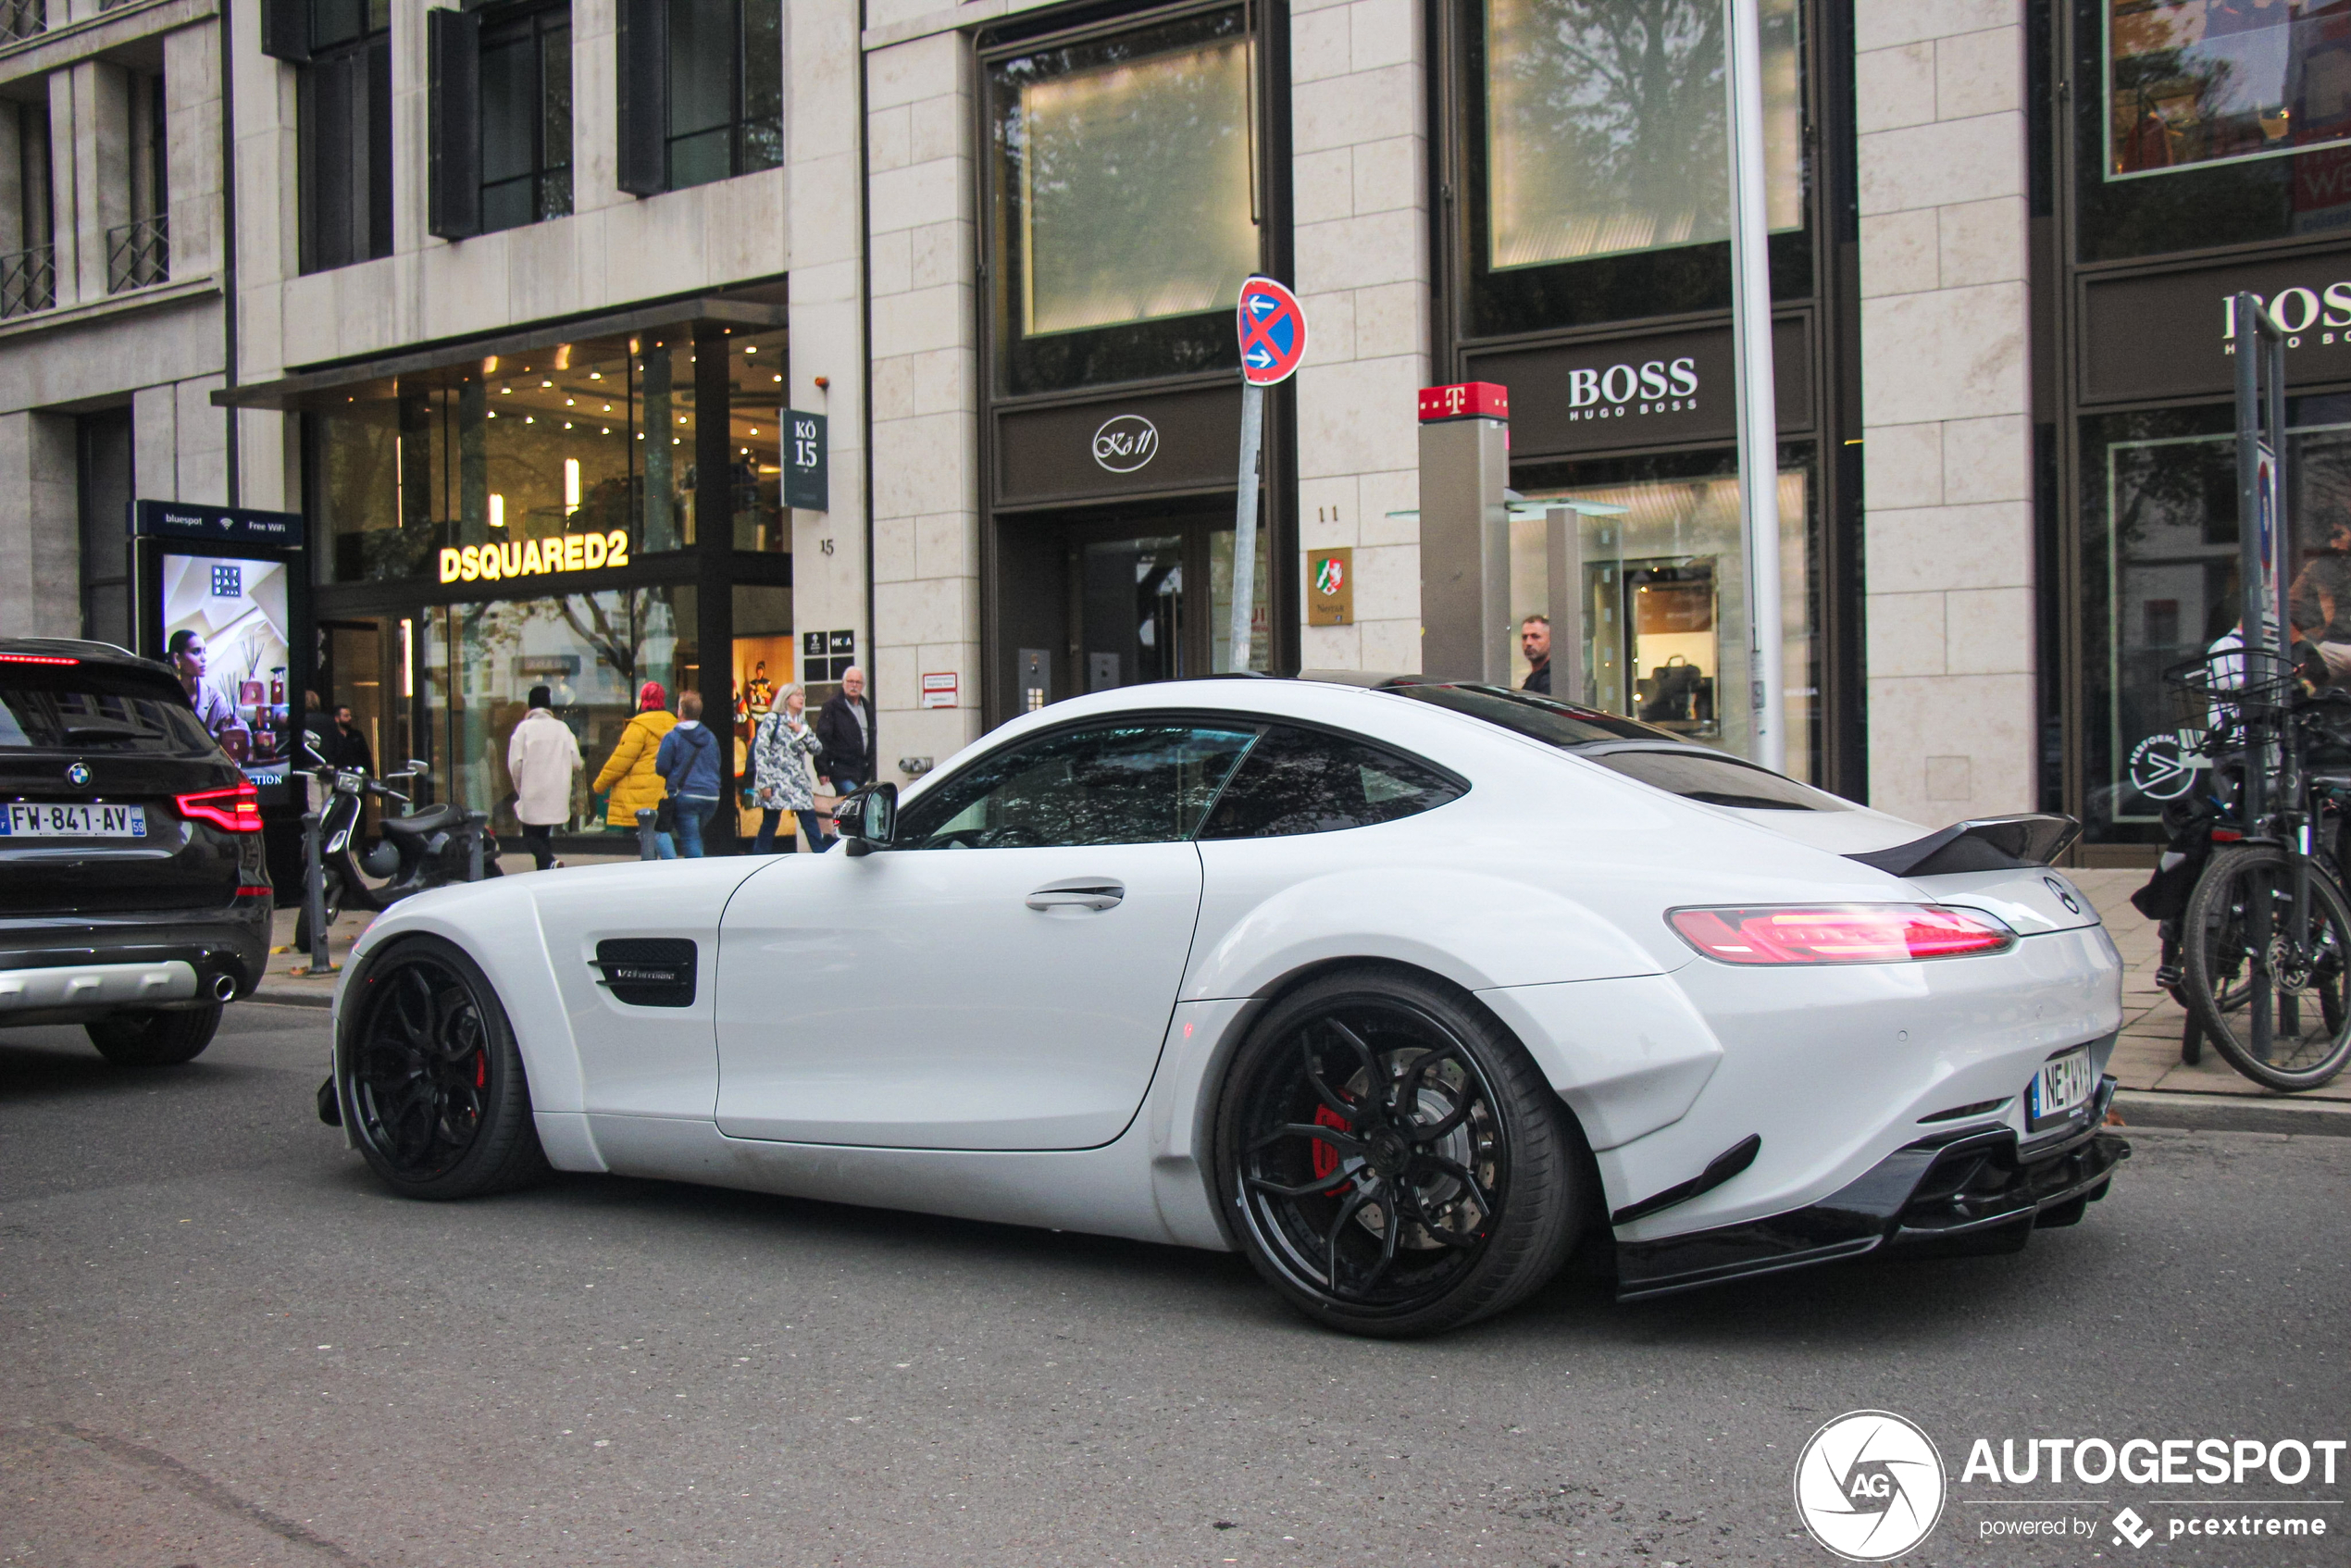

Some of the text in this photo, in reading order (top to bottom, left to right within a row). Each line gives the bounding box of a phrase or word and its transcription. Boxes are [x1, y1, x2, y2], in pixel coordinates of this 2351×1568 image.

[1569, 357, 1698, 407] BOSS
[1570, 399, 1697, 421] HUGO BOSS
[795, 420, 816, 440] KÖ
[795, 440, 817, 467] 15
[166, 514, 286, 533] bluespot Free WiFi
[440, 529, 628, 583] DSQUARED2
[820, 539, 834, 556] 15
[11, 806, 127, 831] FW-841-AV
[132, 821, 144, 833] 59
[2045, 1064, 2064, 1110] NE
